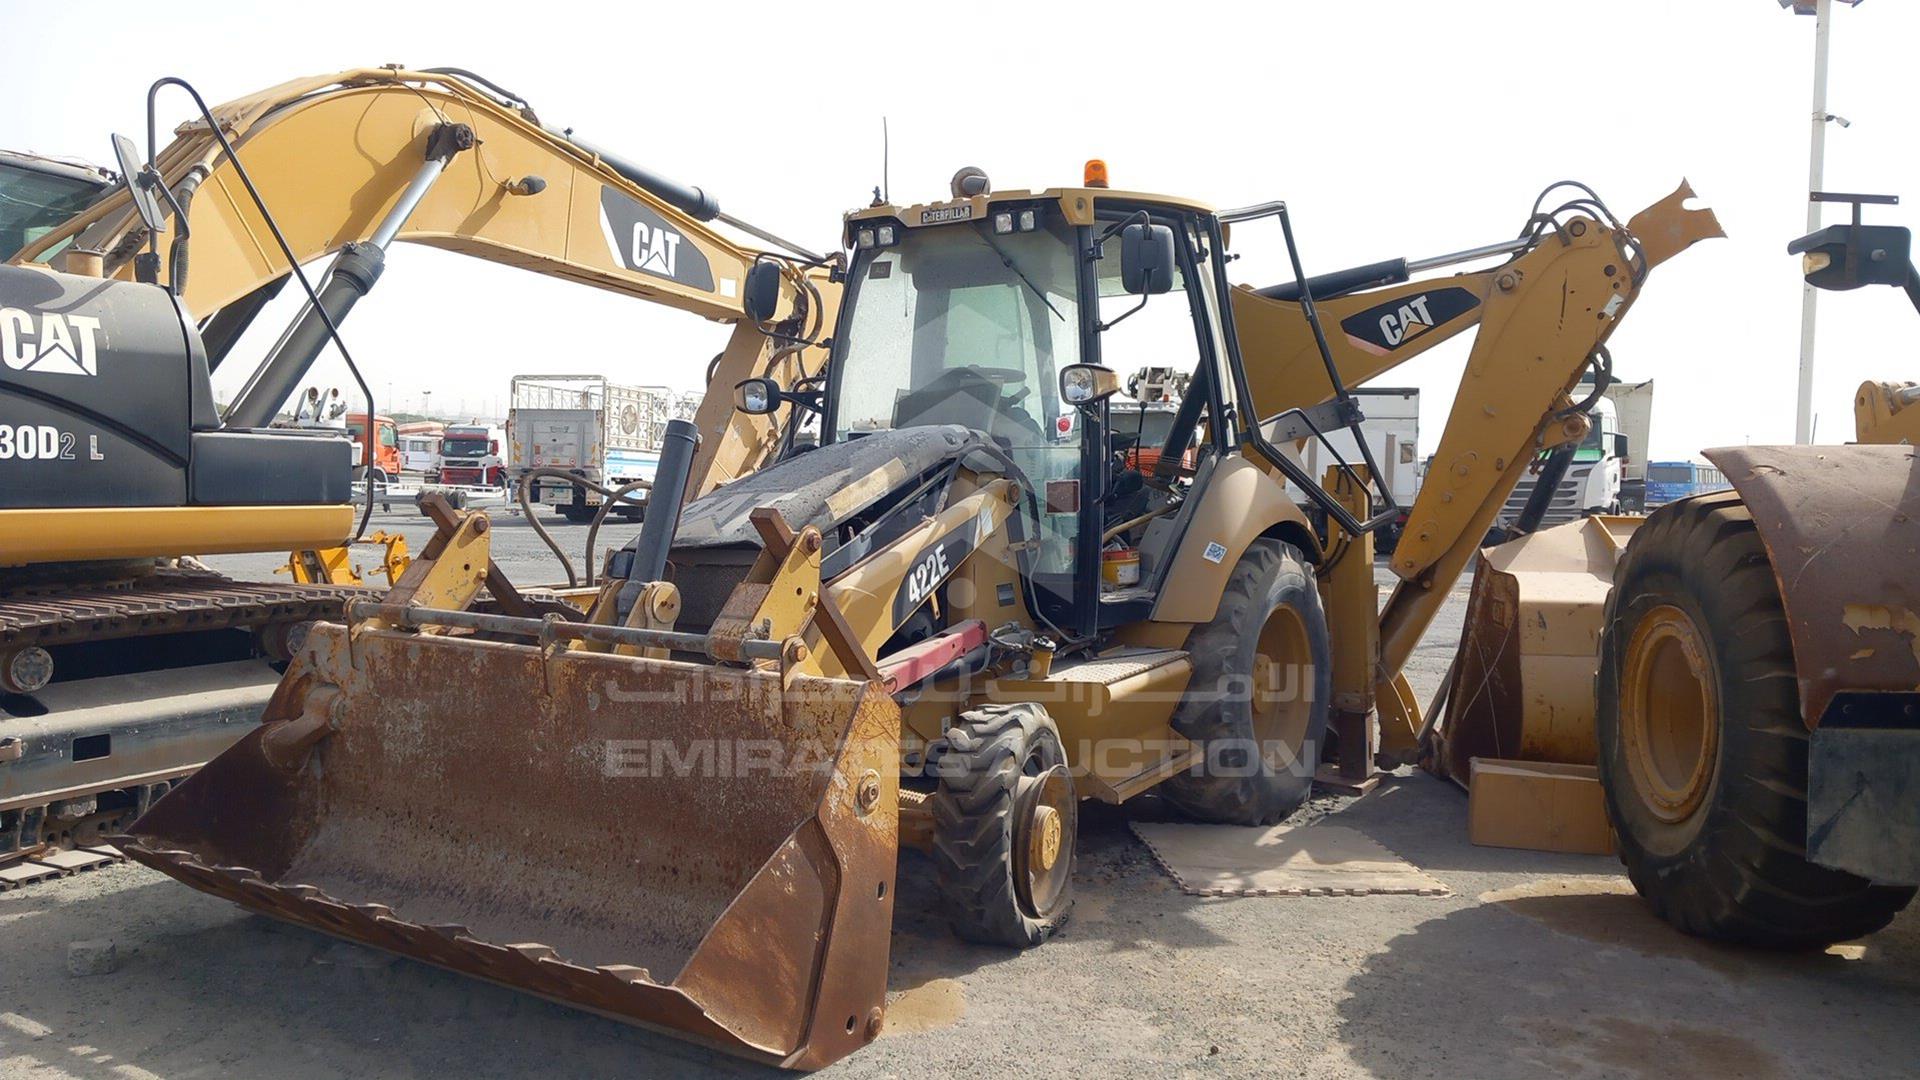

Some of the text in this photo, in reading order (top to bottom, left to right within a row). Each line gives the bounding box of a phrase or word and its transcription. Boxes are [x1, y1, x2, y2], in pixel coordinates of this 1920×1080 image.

[922, 206, 970, 223] CATERPILLAR
[632, 221, 680, 278] CAT
[0, 306, 101, 377] CAT
[1379, 294, 1434, 346] CAT
[89, 434, 105, 461] L
[908, 543, 950, 603] 422E
